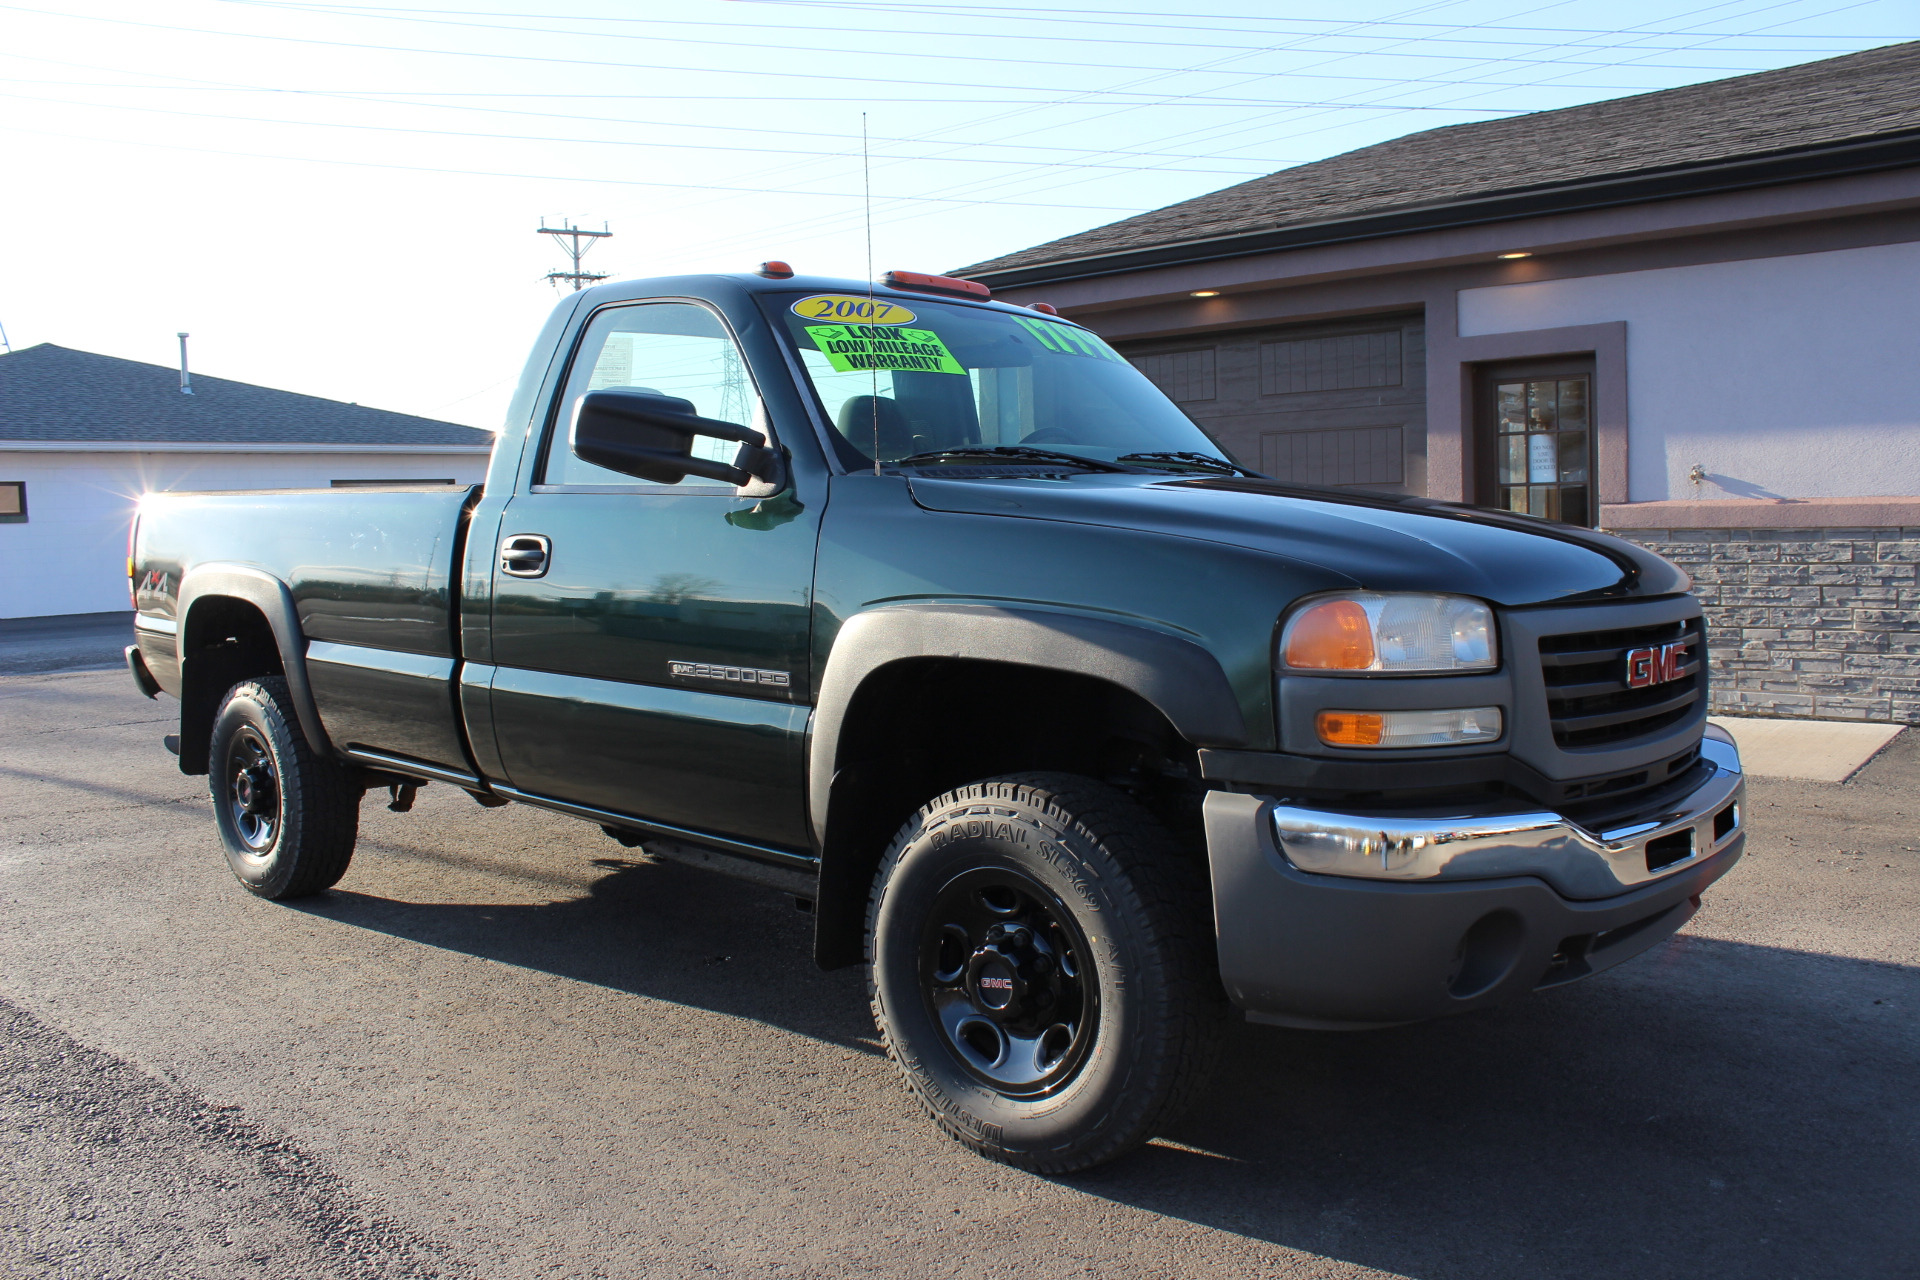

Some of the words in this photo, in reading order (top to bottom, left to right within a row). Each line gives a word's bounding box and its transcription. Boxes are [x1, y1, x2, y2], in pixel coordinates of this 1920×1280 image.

[814, 300, 894, 319] 2007
[844, 325, 908, 342] LOOK
[826, 340, 868, 354] LOW
[869, 341, 946, 358] MILEAGE
[844, 354, 944, 372] WARRANTY
[672, 664, 694, 674] GMC
[1626, 641, 1688, 689] GMC
[930, 820, 1030, 850] RADIAL
[1036, 839, 1101, 912] SL369
[981, 977, 1012, 989] GMC
